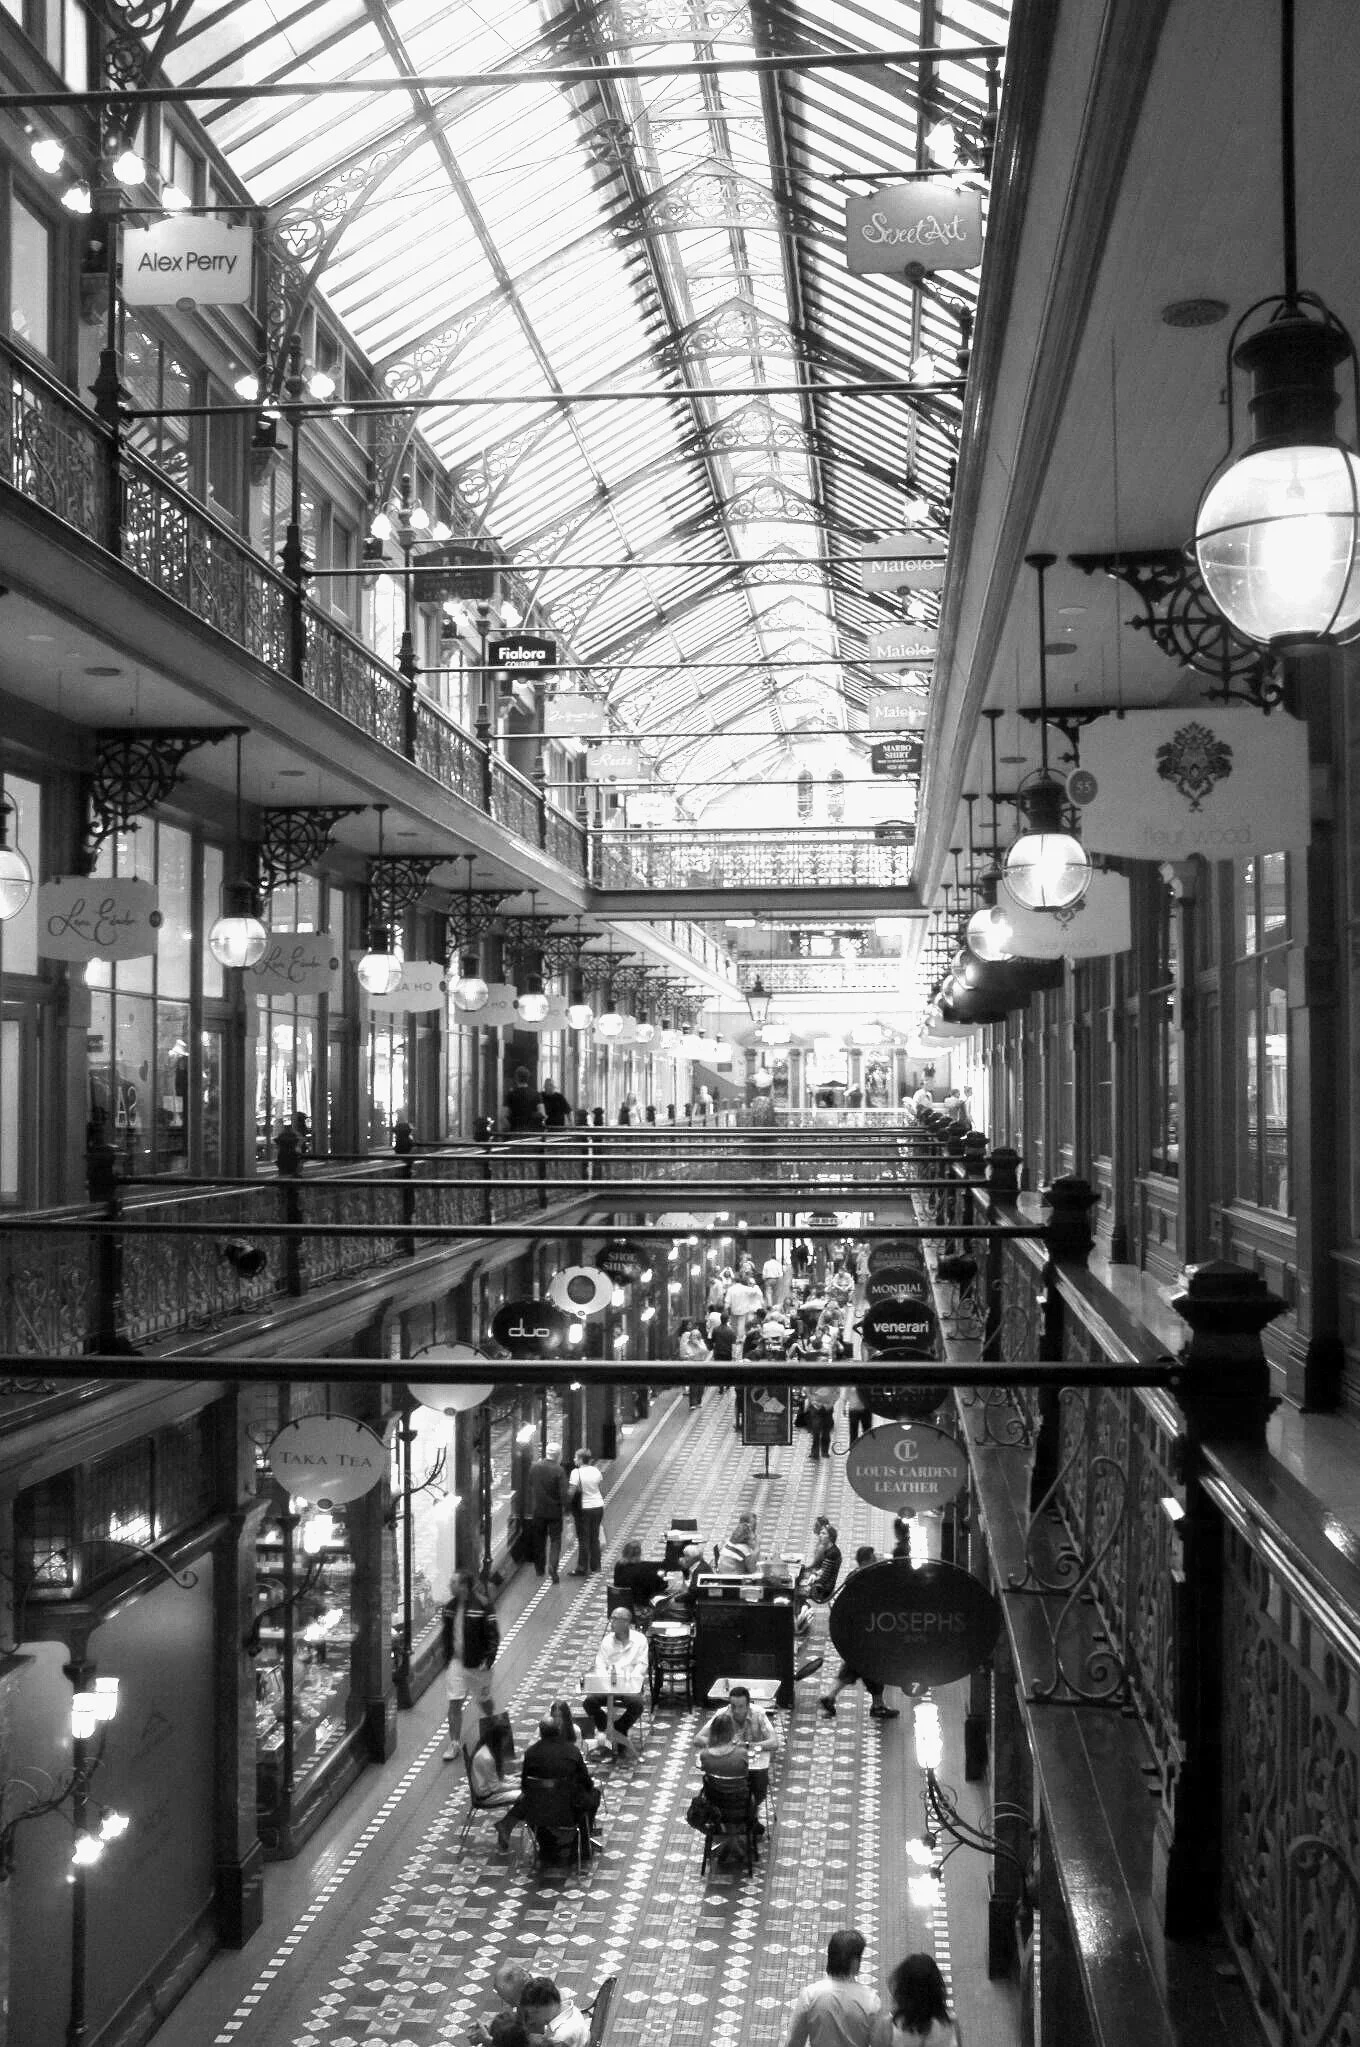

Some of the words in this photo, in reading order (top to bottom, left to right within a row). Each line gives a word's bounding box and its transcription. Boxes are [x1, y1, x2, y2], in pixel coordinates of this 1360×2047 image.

[138, 252, 183, 272] Alex
[186, 251, 237, 274] Perry
[498, 646, 546, 660] Fialora
[872, 1283, 922, 1294] MONDIAL
[508, 1318, 550, 1337] duo
[873, 1321, 929, 1333] venerari
[280, 1451, 328, 1465] TAKA
[336, 1454, 372, 1467] TEA
[856, 1465, 897, 1477] LOUIS
[900, 1466, 957, 1478] CARDINI
[874, 1482, 939, 1493] LEATHER
[865, 1612, 966, 1632] JOSEPHS
[911, 1682, 921, 1695] 7
